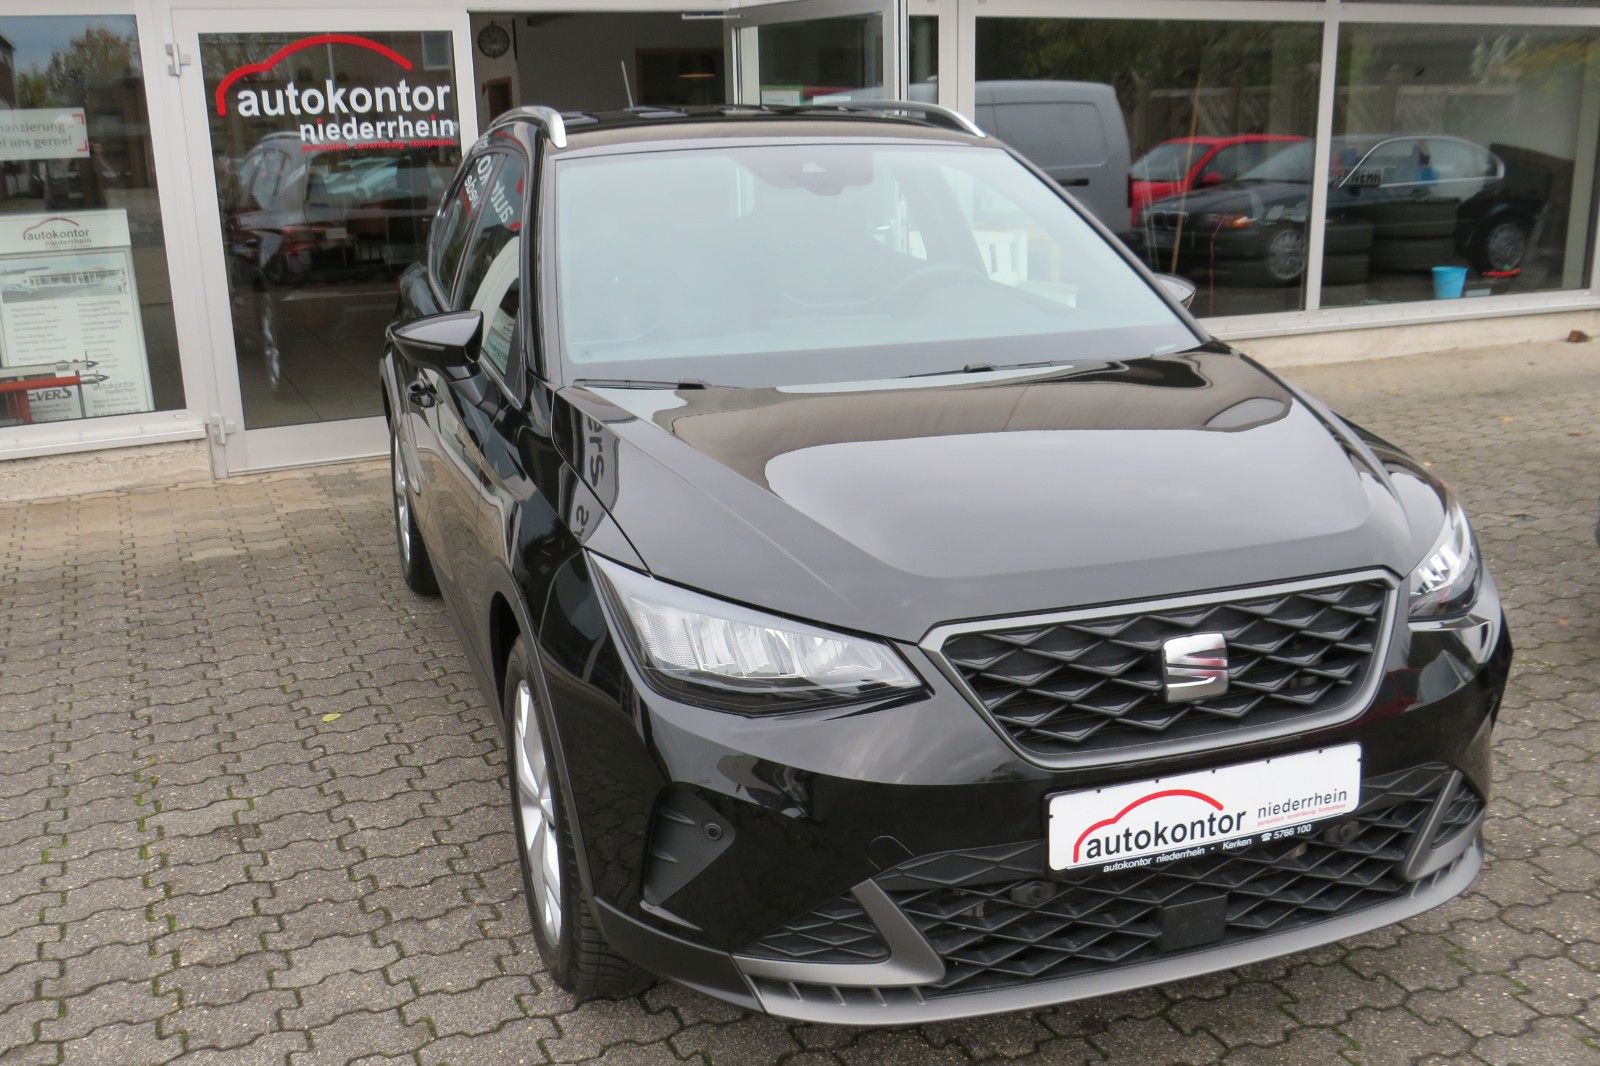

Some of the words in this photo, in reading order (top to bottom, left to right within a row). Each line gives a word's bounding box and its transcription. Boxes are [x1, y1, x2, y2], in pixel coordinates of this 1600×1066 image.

[237, 79, 450, 118] autokontor
[300, 114, 454, 144] niederrhein
[27, 229, 89, 240] autokontor
[1086, 810, 1246, 859] autokontor
[1258, 788, 1347, 818] niederrhein
[1103, 856, 1152, 873] autokontor
[1156, 846, 1205, 863] niederrhein
[1222, 838, 1253, 851] Kerken
[1297, 823, 1312, 834] 100
